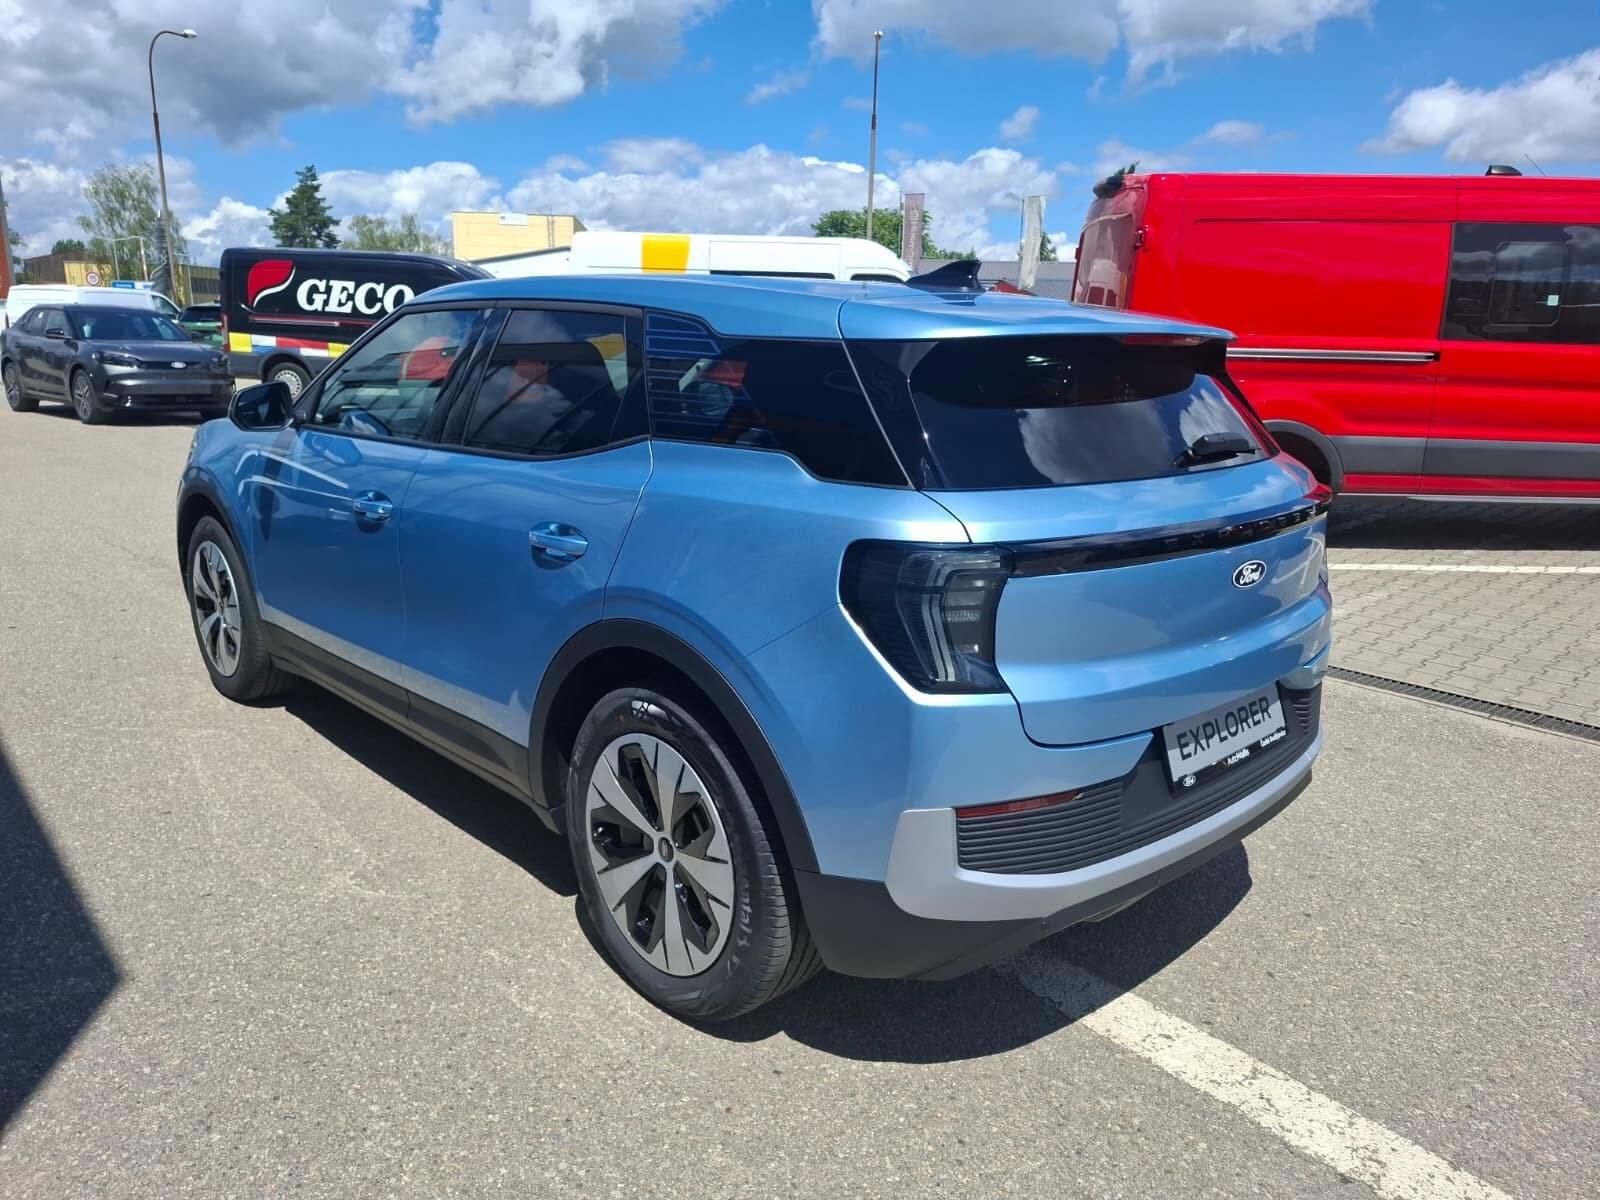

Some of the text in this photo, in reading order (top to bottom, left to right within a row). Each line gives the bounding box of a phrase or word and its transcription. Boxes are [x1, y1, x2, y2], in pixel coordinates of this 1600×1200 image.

[296, 278, 416, 315] GECO
[1238, 563, 1263, 585] Ford
[1175, 696, 1272, 761] EXPLORER
